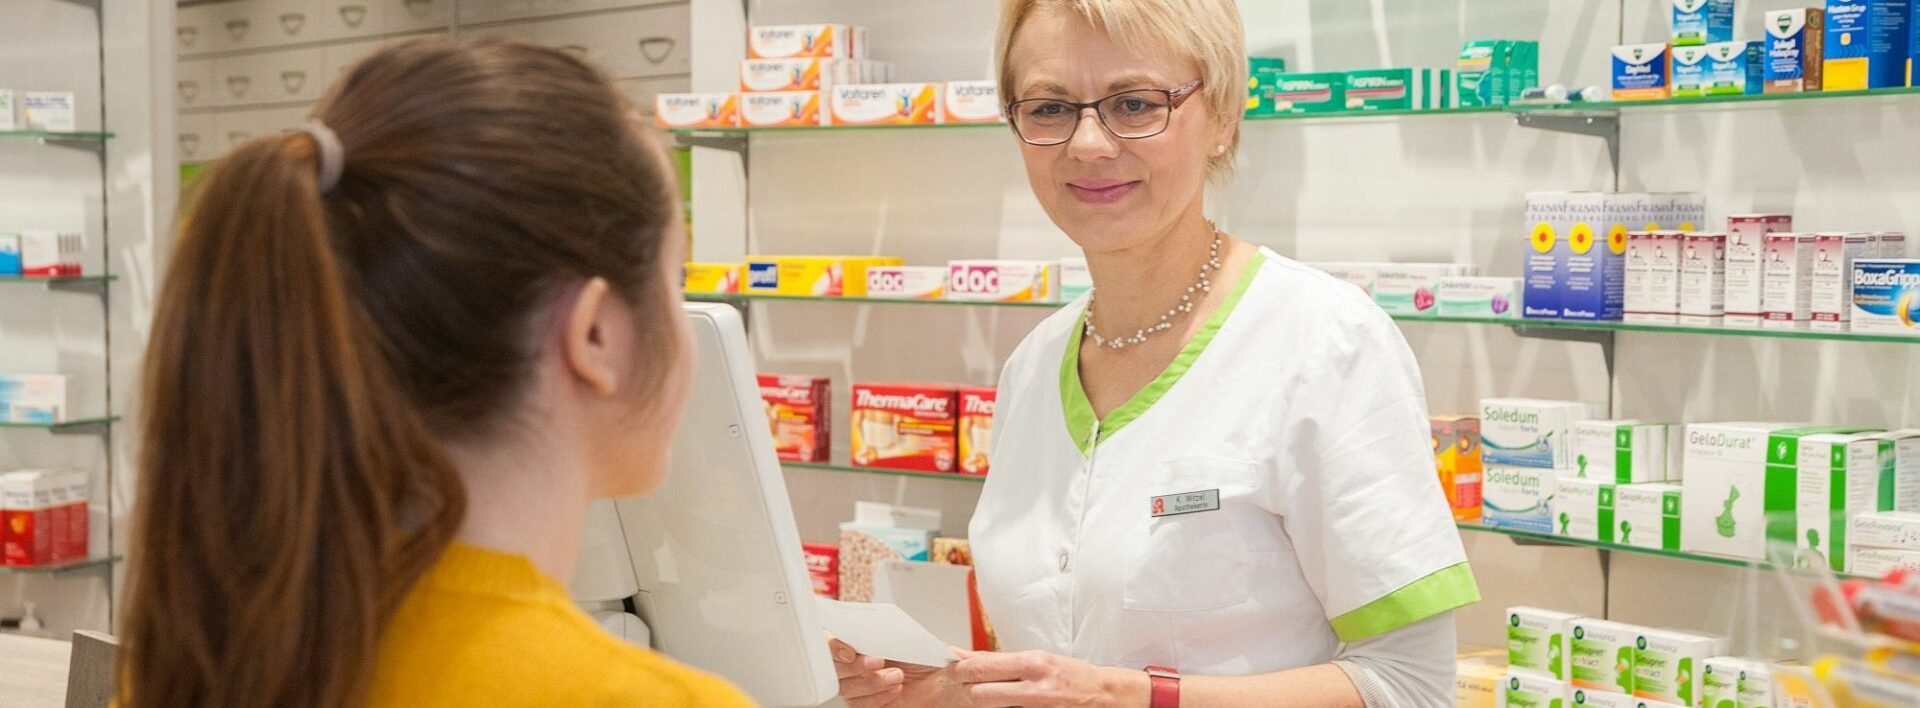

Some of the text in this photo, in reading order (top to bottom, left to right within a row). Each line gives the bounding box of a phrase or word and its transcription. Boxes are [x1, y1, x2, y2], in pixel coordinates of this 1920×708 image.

[840, 88, 886, 100] Voltaren
[868, 270, 903, 291] doc
[951, 265, 999, 293] doc
[1855, 269, 1920, 290] BoxaGripp
[856, 389, 948, 412] ThermaCare
[1484, 406, 1538, 424] Soledum
[1690, 431, 1751, 449] GeloDurat
[1487, 467, 1540, 487] Soledum
